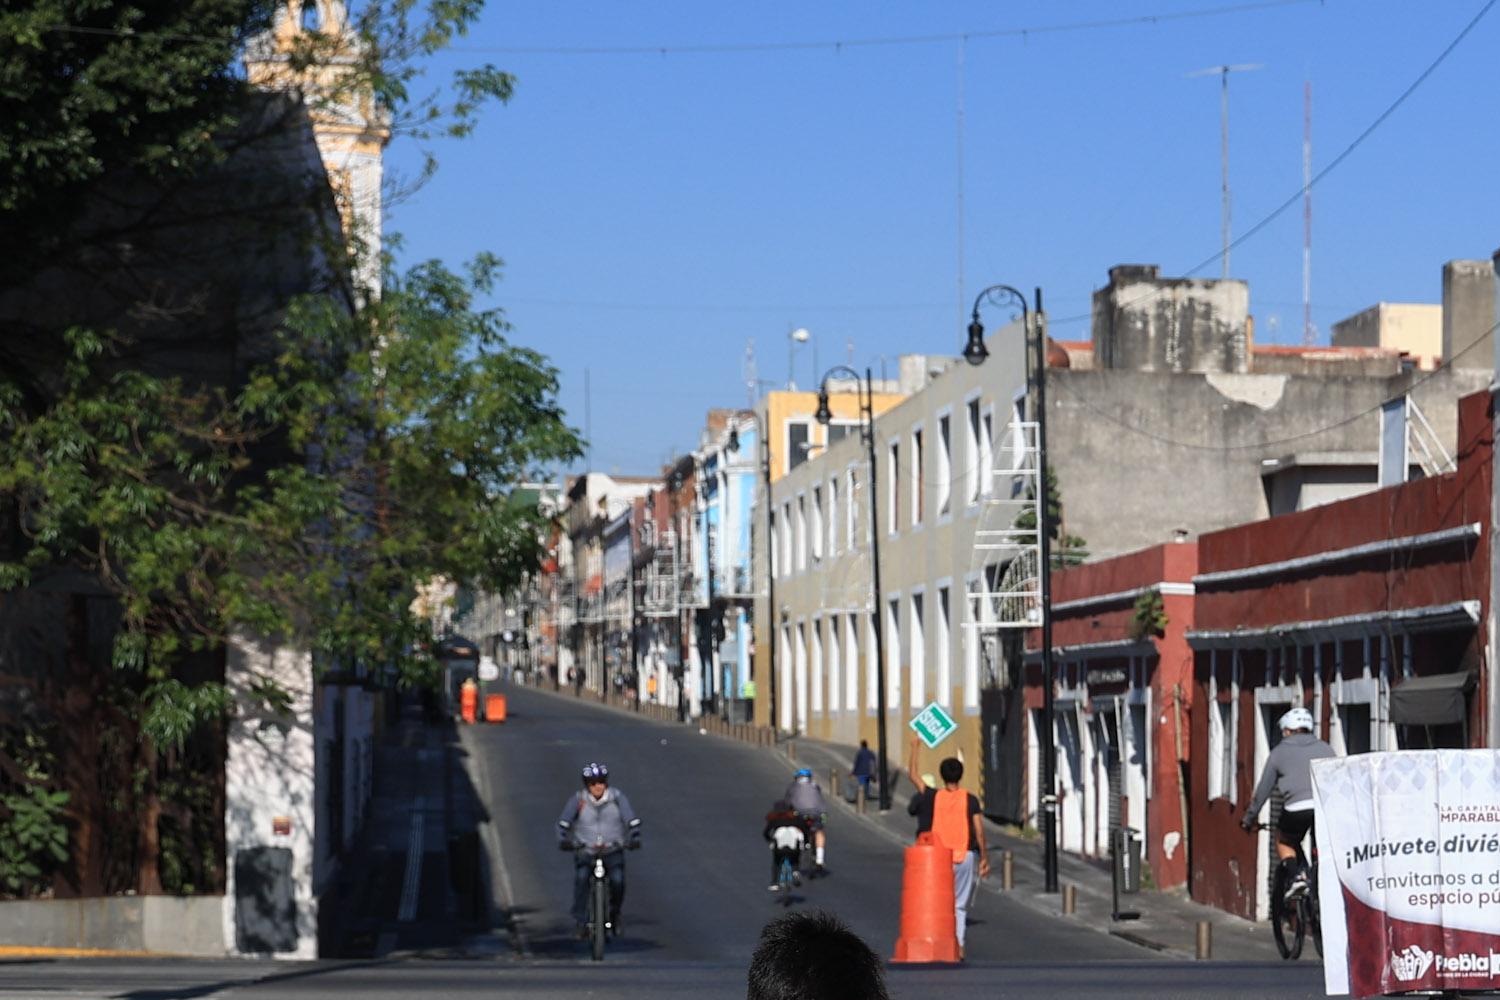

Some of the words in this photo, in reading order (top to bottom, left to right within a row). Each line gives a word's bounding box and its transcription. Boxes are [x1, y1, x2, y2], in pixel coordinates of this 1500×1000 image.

[919, 710, 946, 738] SIGA
[1471, 872, 1483, 885] a
[1408, 889, 1473, 910] espacio
